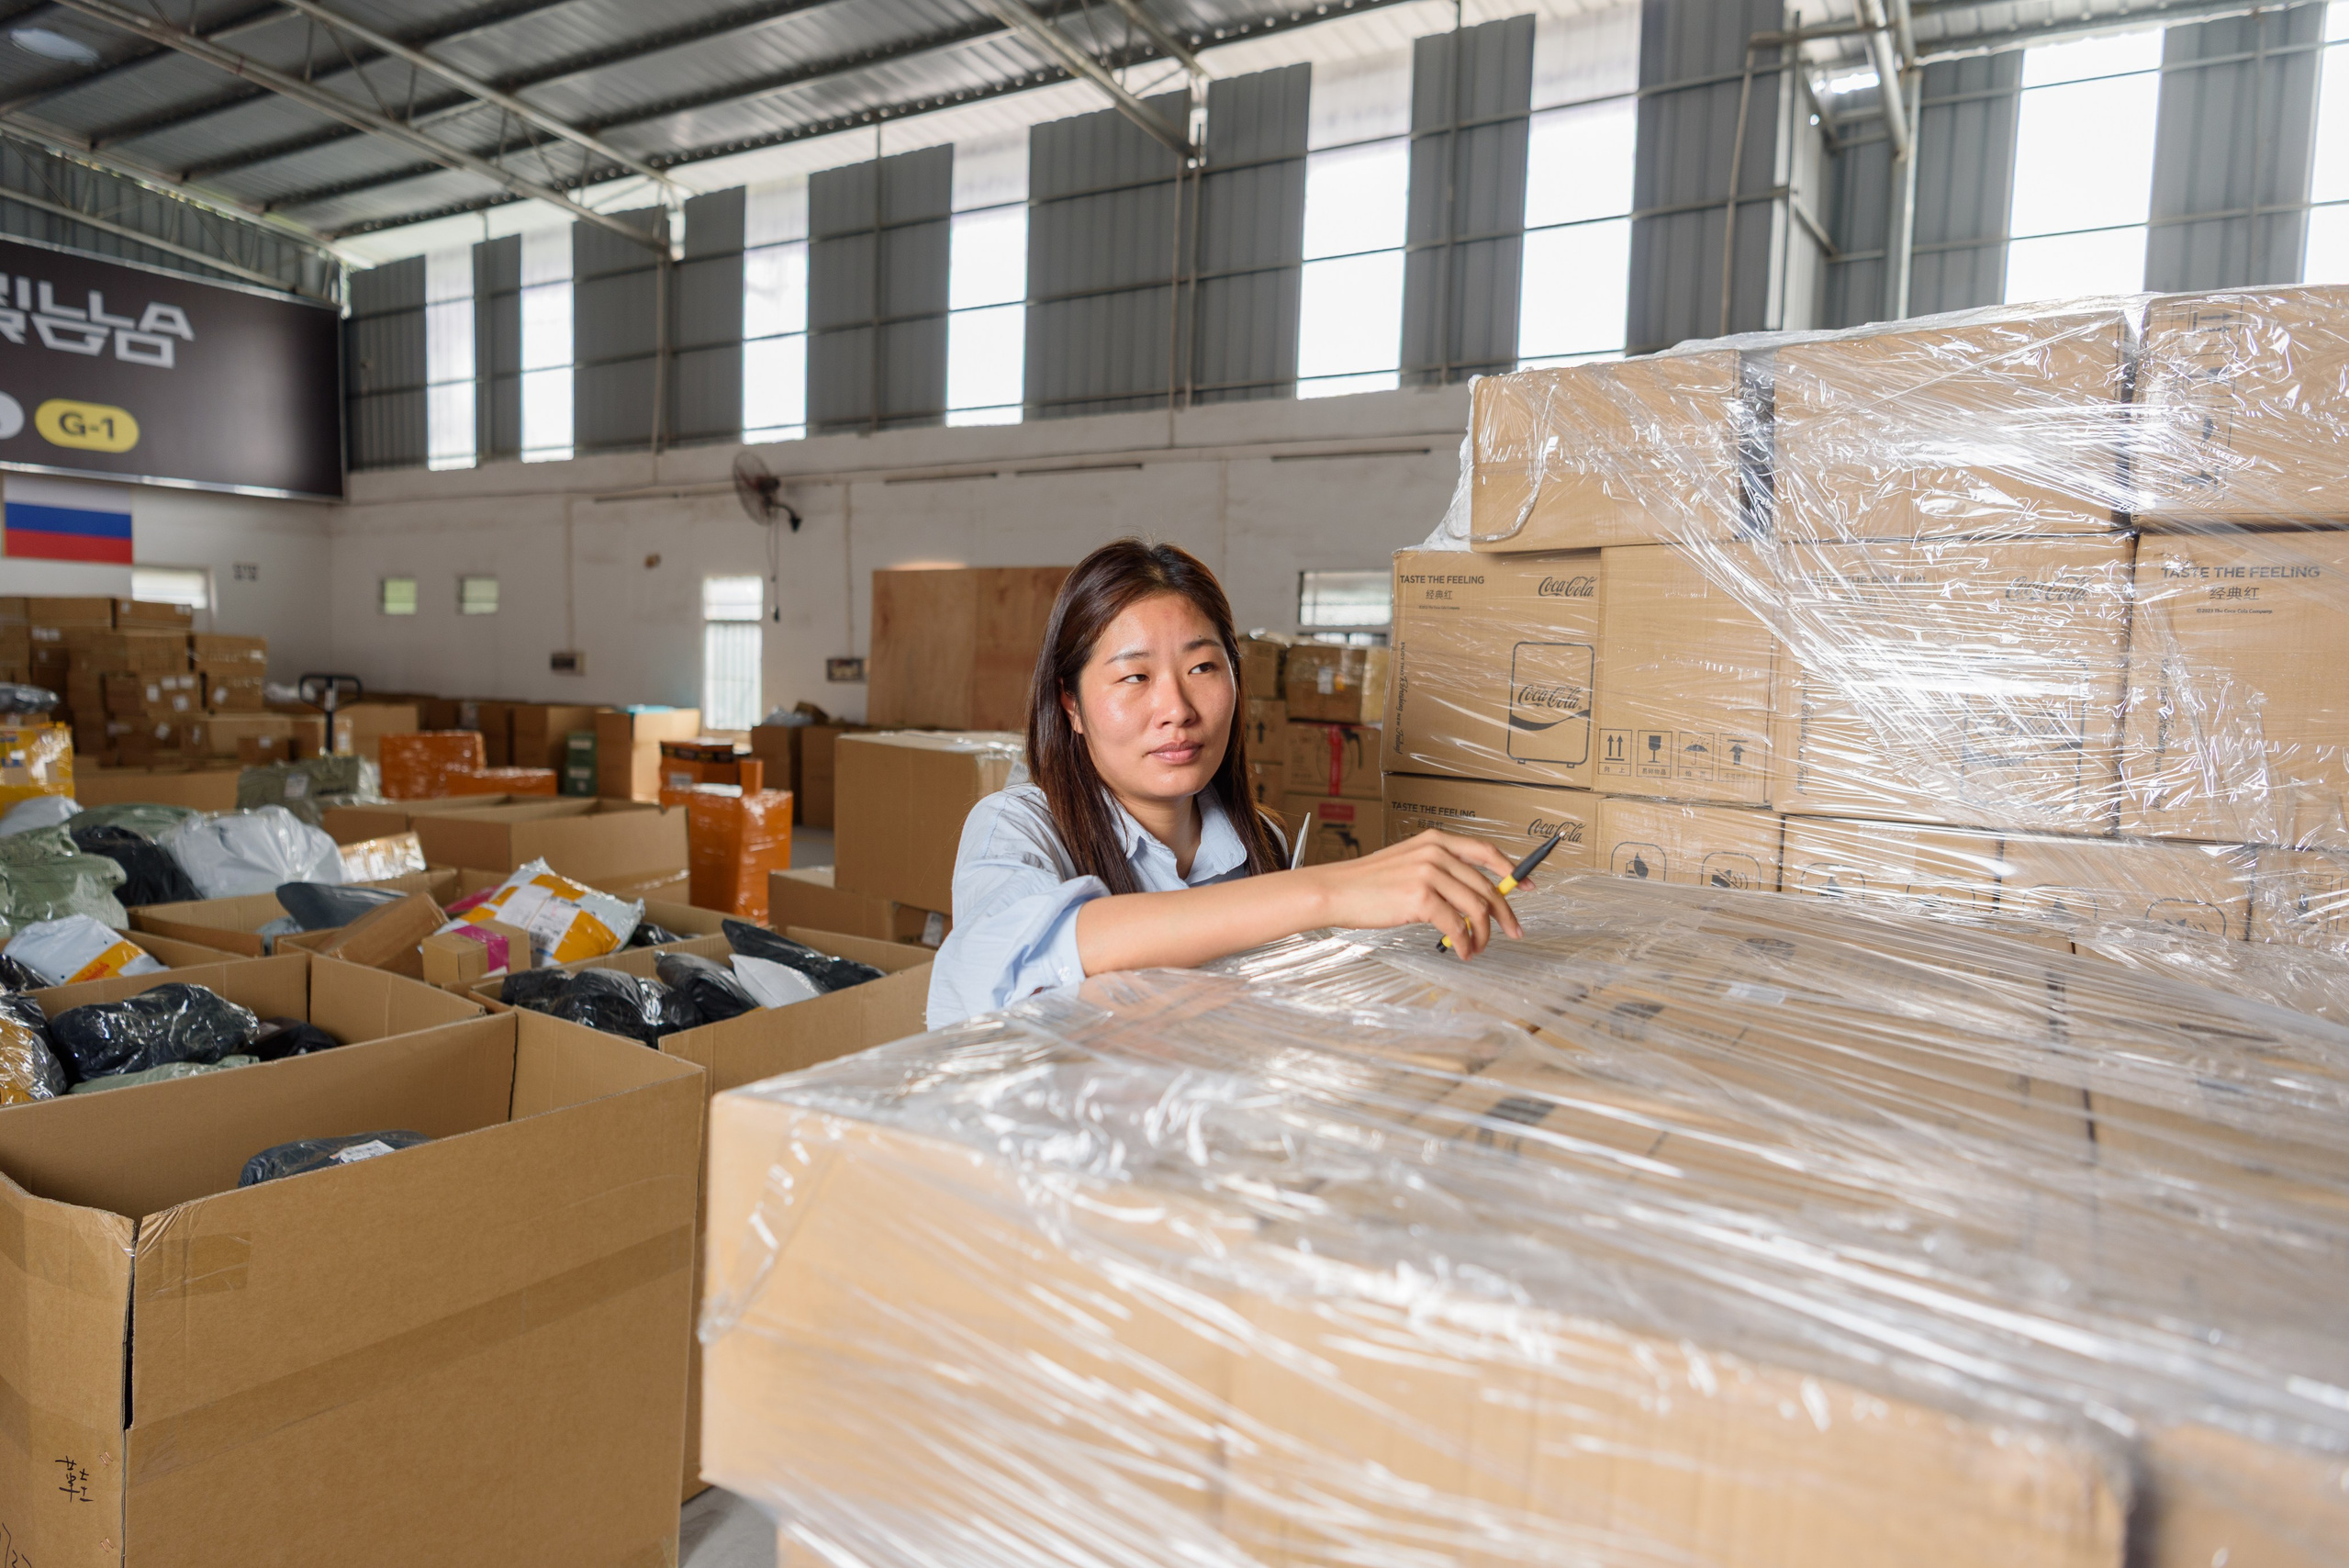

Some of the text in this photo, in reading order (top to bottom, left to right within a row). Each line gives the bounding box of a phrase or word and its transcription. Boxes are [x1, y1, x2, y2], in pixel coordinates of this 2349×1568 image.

[0, 272, 196, 342] ILLA
[59, 411, 115, 440] G-1
[1400, 575, 1484, 585] TASTE THE FEELING
[2161, 566, 2321, 578] TASTE THE FEELING
[1426, 589, 1453, 600] 经典红
[1538, 576, 1597, 597] Coca-Cola
[2209, 587, 2260, 600] 经典红
[1392, 801, 1476, 818] TASTE THE FEELING
[55, 1456, 94, 1503] 鞋
